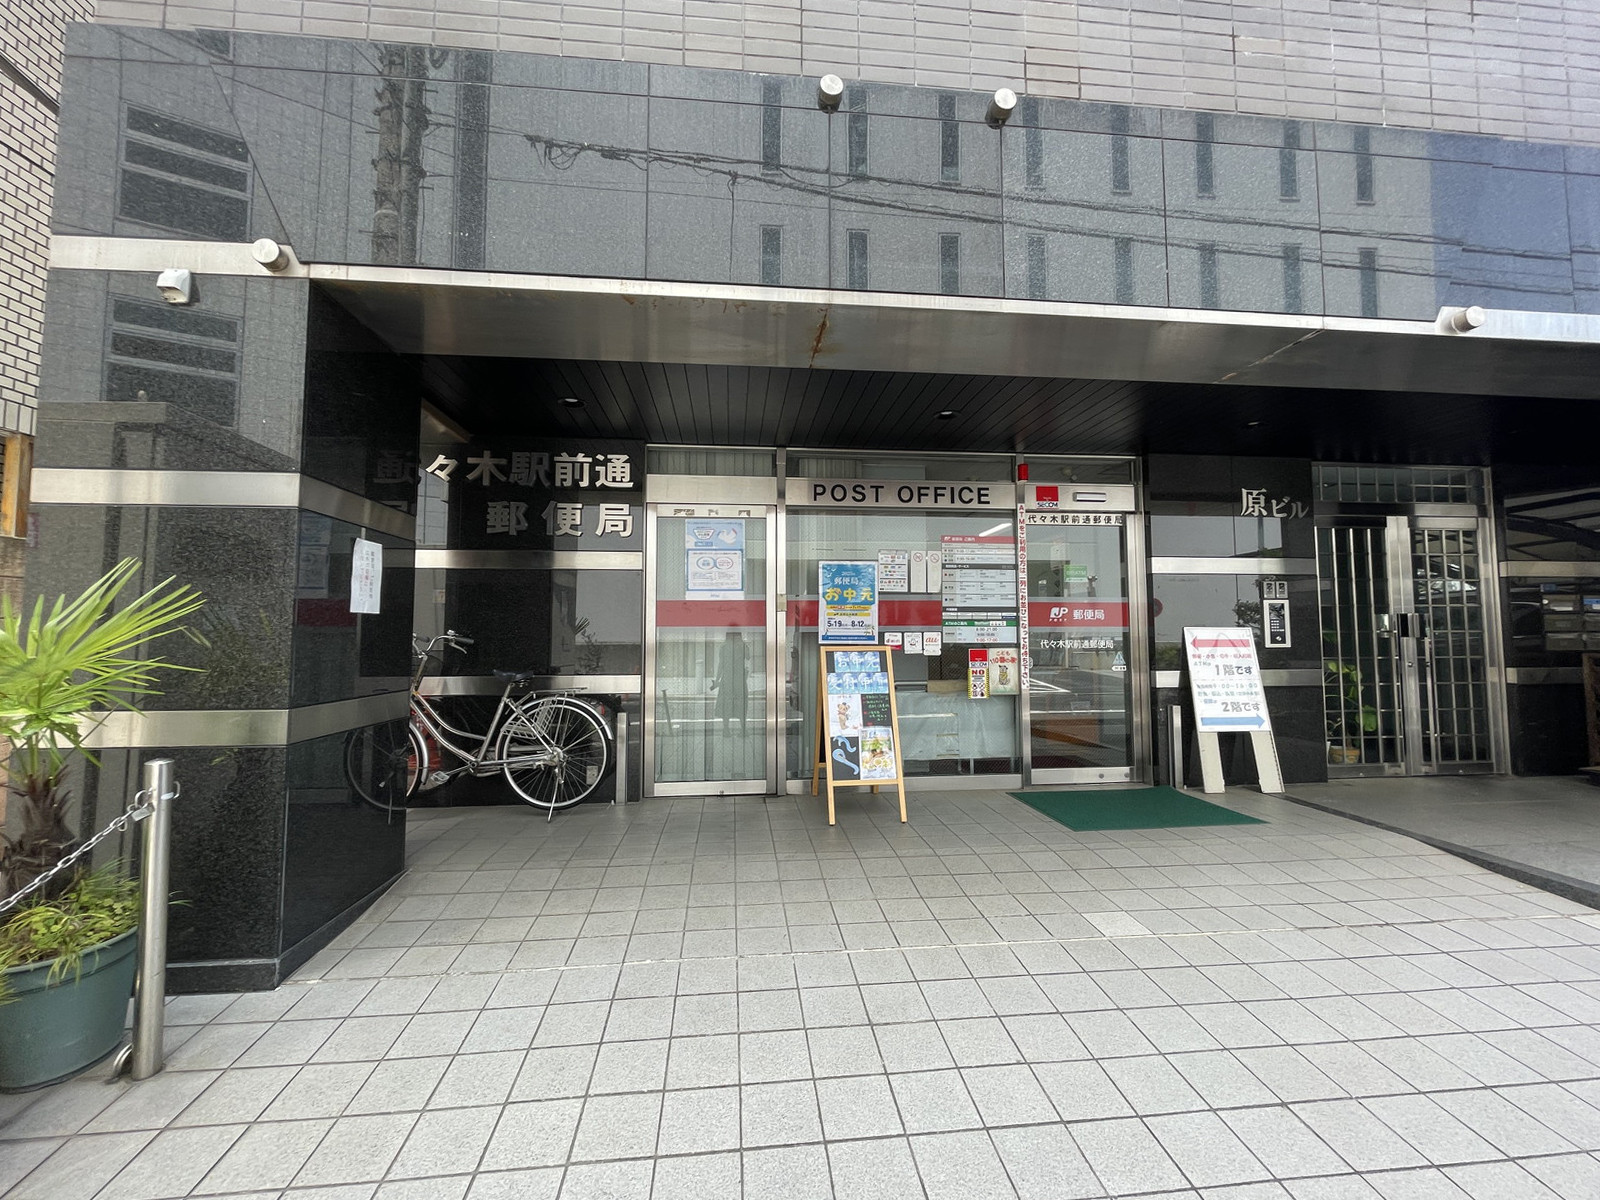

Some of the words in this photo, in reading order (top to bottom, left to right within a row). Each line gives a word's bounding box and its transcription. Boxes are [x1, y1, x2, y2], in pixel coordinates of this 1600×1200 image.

[813, 484, 885, 503] POST
[897, 486, 991, 504] OFFICE
[1240, 488, 1309, 520] 原ビル
[486, 500, 635, 537] 郵便局
[1027, 514, 1123, 524] 代々木駅前通郵便局
[825, 587, 874, 602] お中元
[1072, 609, 1105, 621] 郵便局
[1214, 664, 1253, 676] 1階です
[1221, 701, 1260, 712] 2階です
